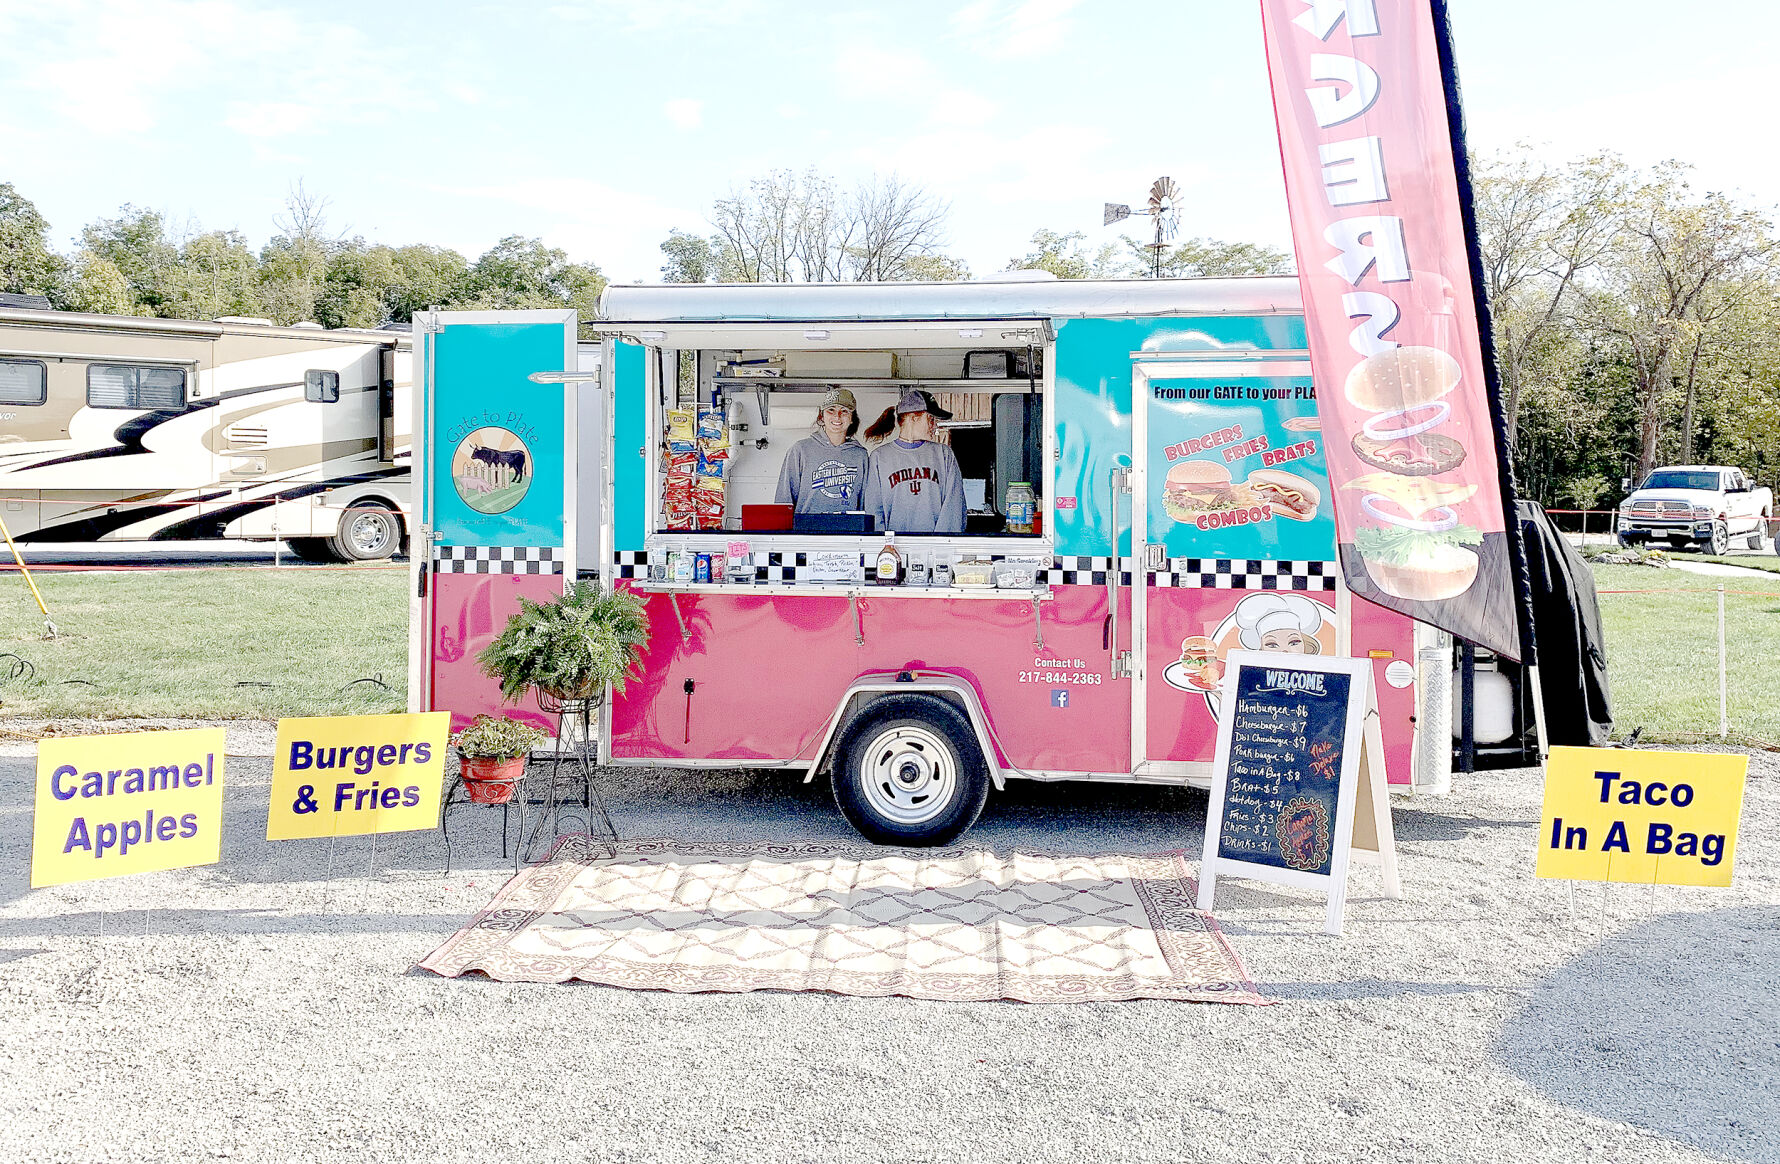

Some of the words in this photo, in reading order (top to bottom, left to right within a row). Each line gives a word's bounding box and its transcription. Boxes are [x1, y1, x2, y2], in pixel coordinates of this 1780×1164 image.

[1154, 386, 1186, 399] From
[1189, 388, 1211, 399] our
[1213, 386, 1244, 399] GATE
[1246, 386, 1259, 399] to
[1262, 388, 1291, 401] your
[1294, 386, 1317, 400] PLA
[446, 415, 479, 443] Gate
[482, 408, 500, 424] to
[505, 411, 539, 446] Plate
[1163, 424, 1244, 462] BURGERS
[1221, 435, 1269, 463] FRIES
[1260, 440, 1317, 467] BRATS
[823, 474, 857, 489] UNIVERSITY
[888, 466, 940, 489] INDIANA
[1195, 504, 1273, 531] COMBOS
[1034, 657, 1071, 668] Contact
[1073, 658, 1086, 668] Us
[1018, 671, 1102, 685] 217-844-2363
[1265, 670, 1325, 691] WELCOME
[289, 739, 432, 776] Burgers
[1230, 760, 1248, 774] Taco
[50, 753, 214, 801] Caramel
[1594, 772, 1695, 809] Taco
[292, 784, 319, 816] &
[334, 781, 421, 814] Fries
[63, 809, 199, 860] Apples
[1223, 820, 1247, 834] Chips
[1550, 818, 1589, 852] In
[1601, 822, 1631, 854] A
[1647, 823, 1727, 867] Bag
